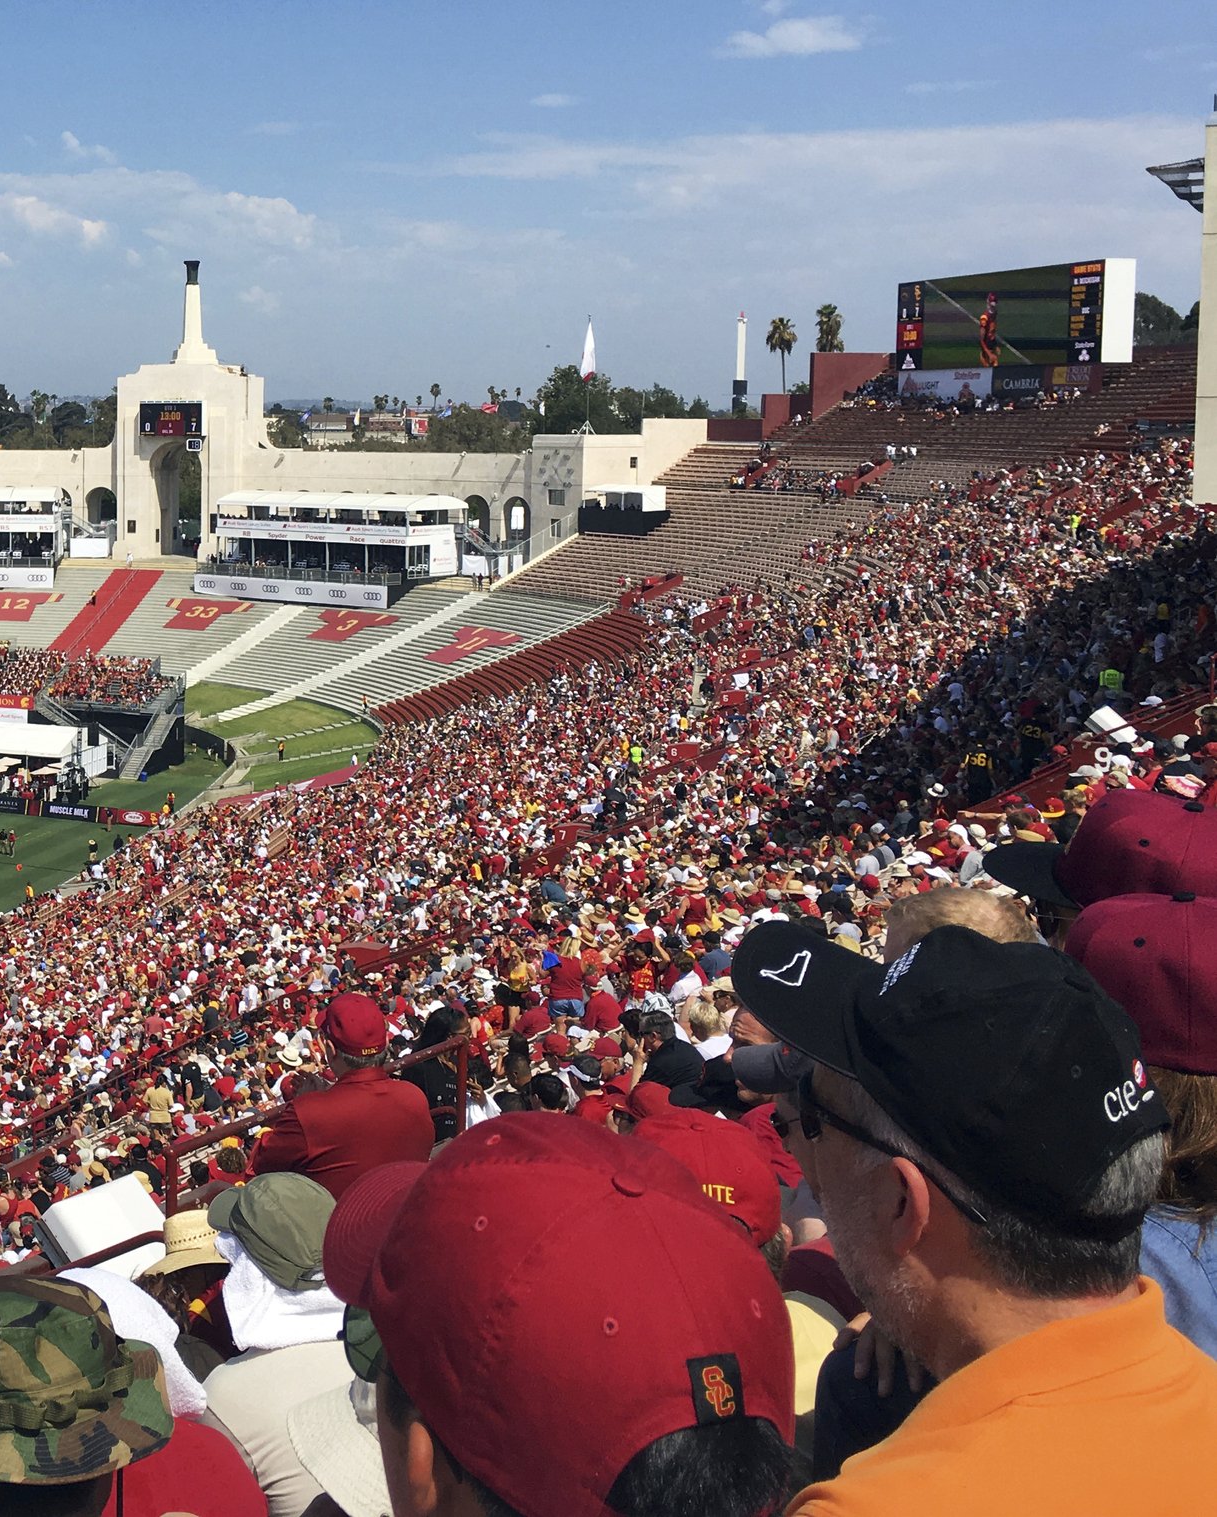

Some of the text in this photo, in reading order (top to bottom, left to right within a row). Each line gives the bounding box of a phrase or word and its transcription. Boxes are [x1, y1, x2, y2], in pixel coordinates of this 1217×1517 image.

[1067, 366, 1092, 374] CREDIT
[1002, 378, 1040, 390] CAMBRIA
[1066, 374, 1090, 382] UNION
[160, 412, 181, 420] 13:00
[145, 422, 197, 432] 0 7
[2, 598, 28, 610] 12
[184, 606, 218, 618] 33
[347, 620, 360, 632] 3
[456, 638, 490, 650] 11
[1024, 724, 1042, 738] 23
[671, 748, 678, 757] 6
[1094, 746, 1113, 773] 9
[50, 805, 90, 818] MUSCLE MILK
[559, 830, 566, 840] 7
[283, 998, 291, 1010] 8
[701, 1366, 736, 1418] SC
